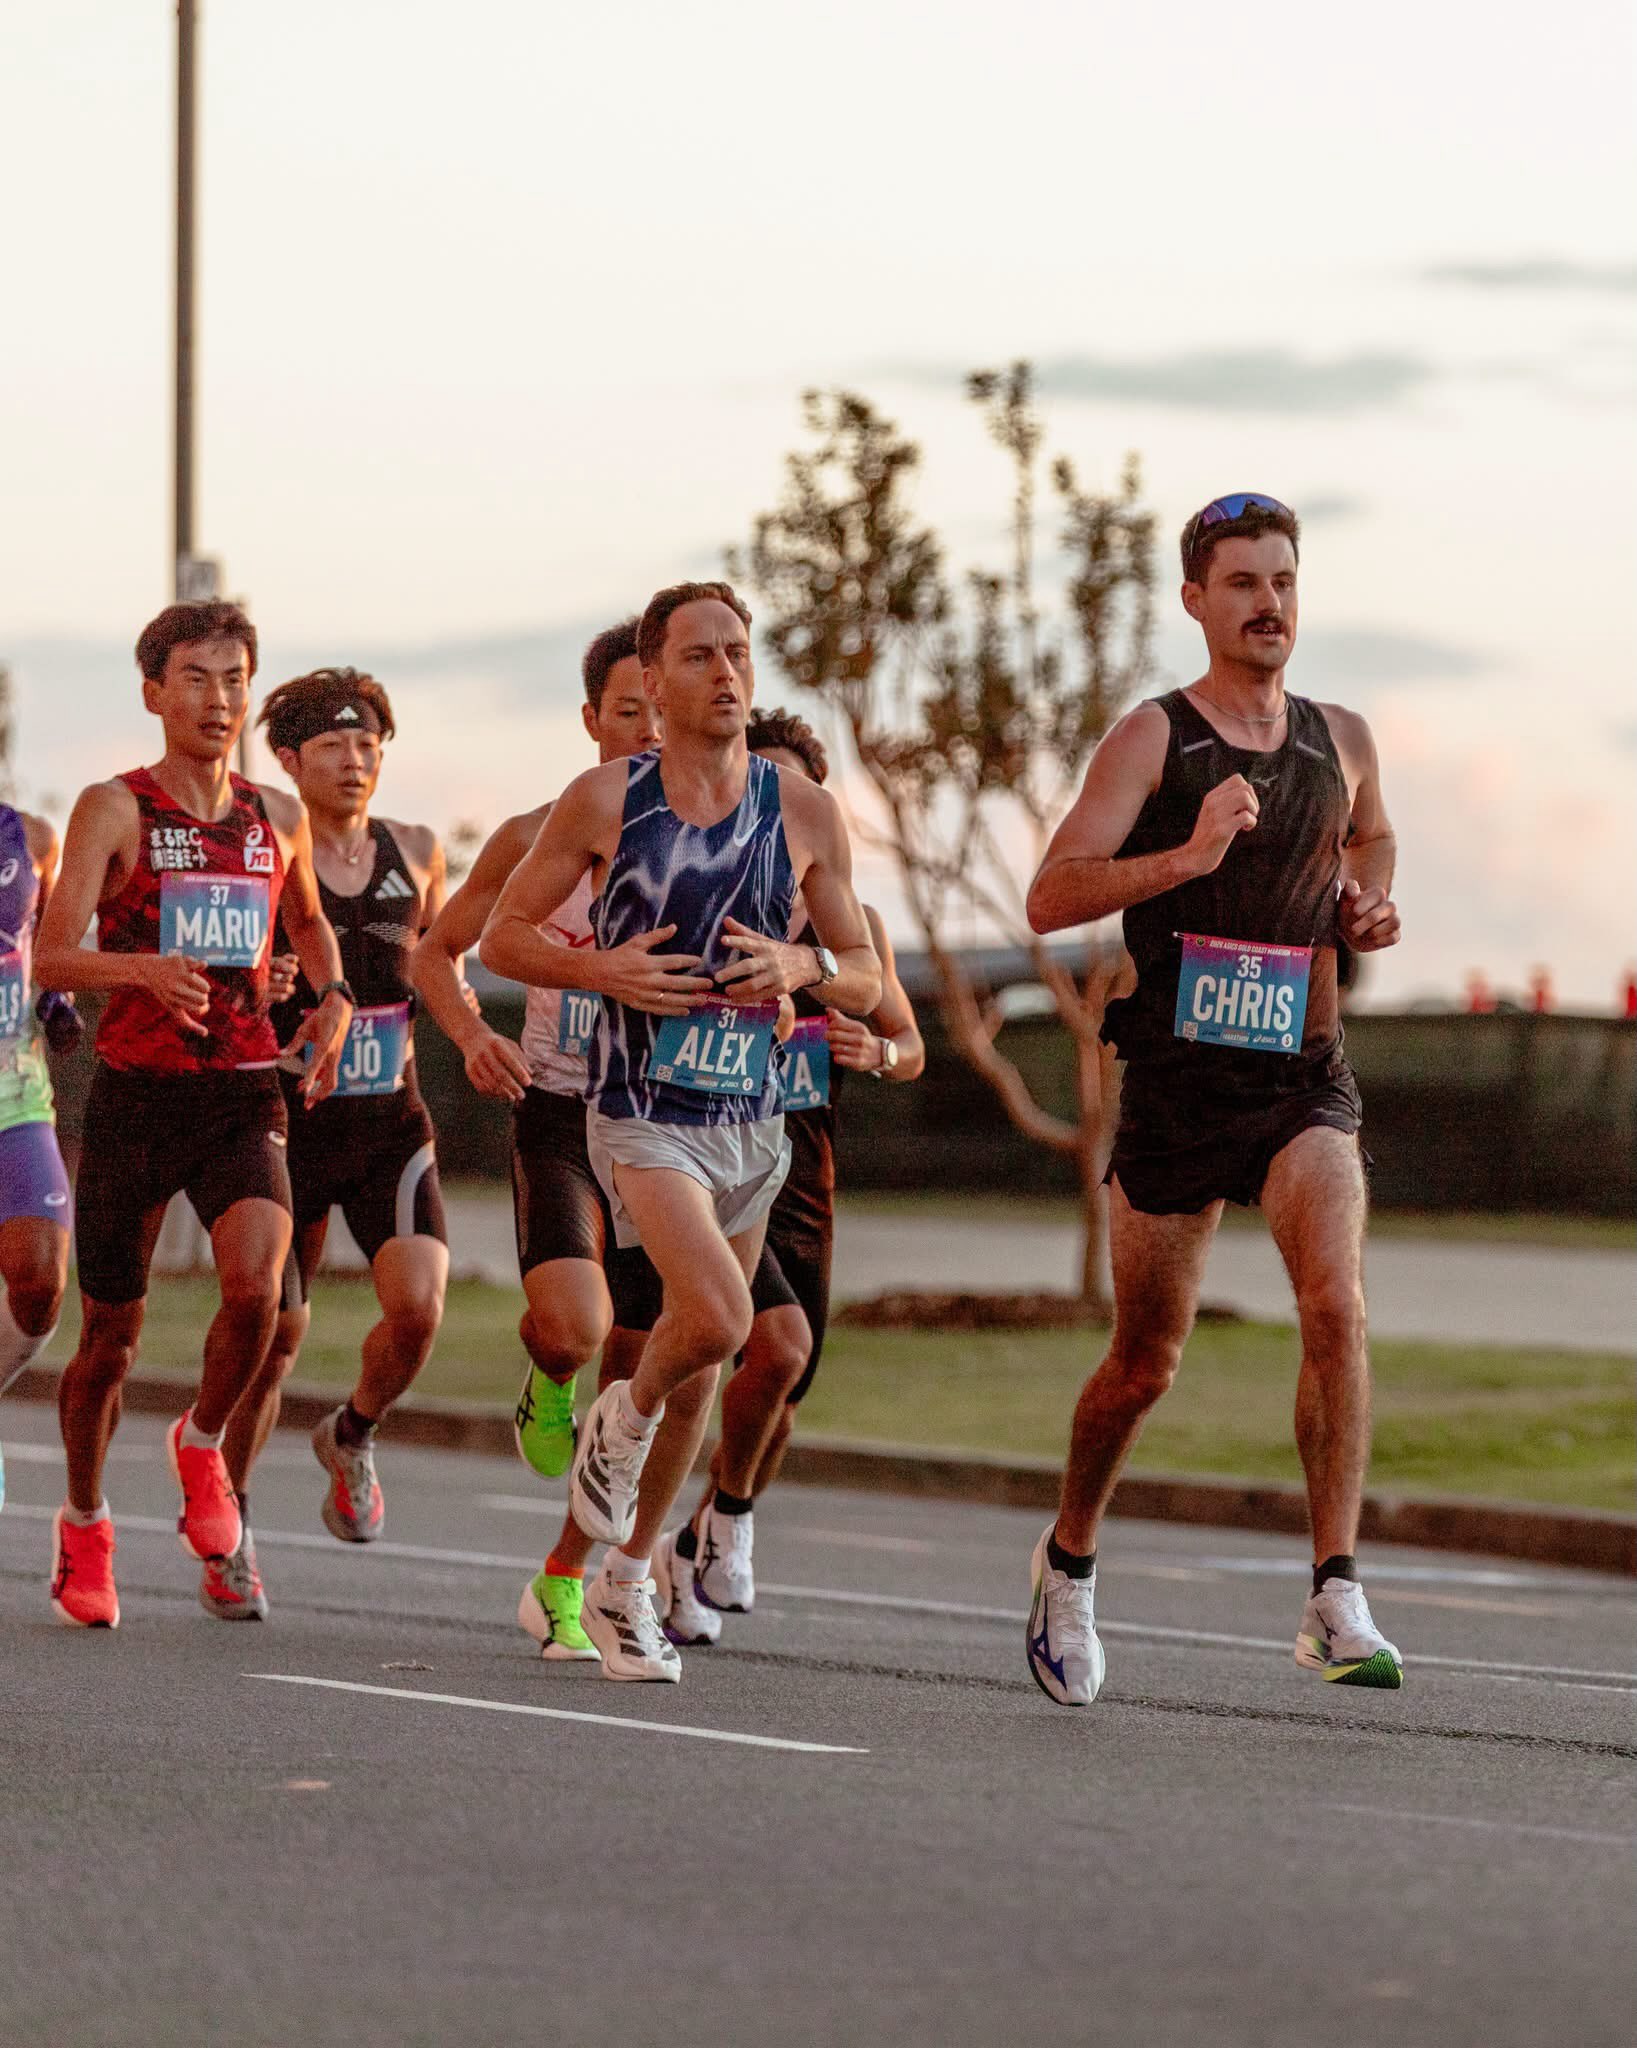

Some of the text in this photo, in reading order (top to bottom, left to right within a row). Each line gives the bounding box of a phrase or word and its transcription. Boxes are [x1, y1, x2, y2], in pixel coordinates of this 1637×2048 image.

[209, 885, 230, 906] 37
[175, 905, 260, 951] MARU
[1237, 954, 1263, 980] 35
[718, 1007, 739, 1030] 31
[1192, 974, 1295, 1032] CHRIS
[351, 1018, 374, 1040] 24
[343, 1038, 381, 1081] JO
[673, 1025, 756, 1076] ALEX
